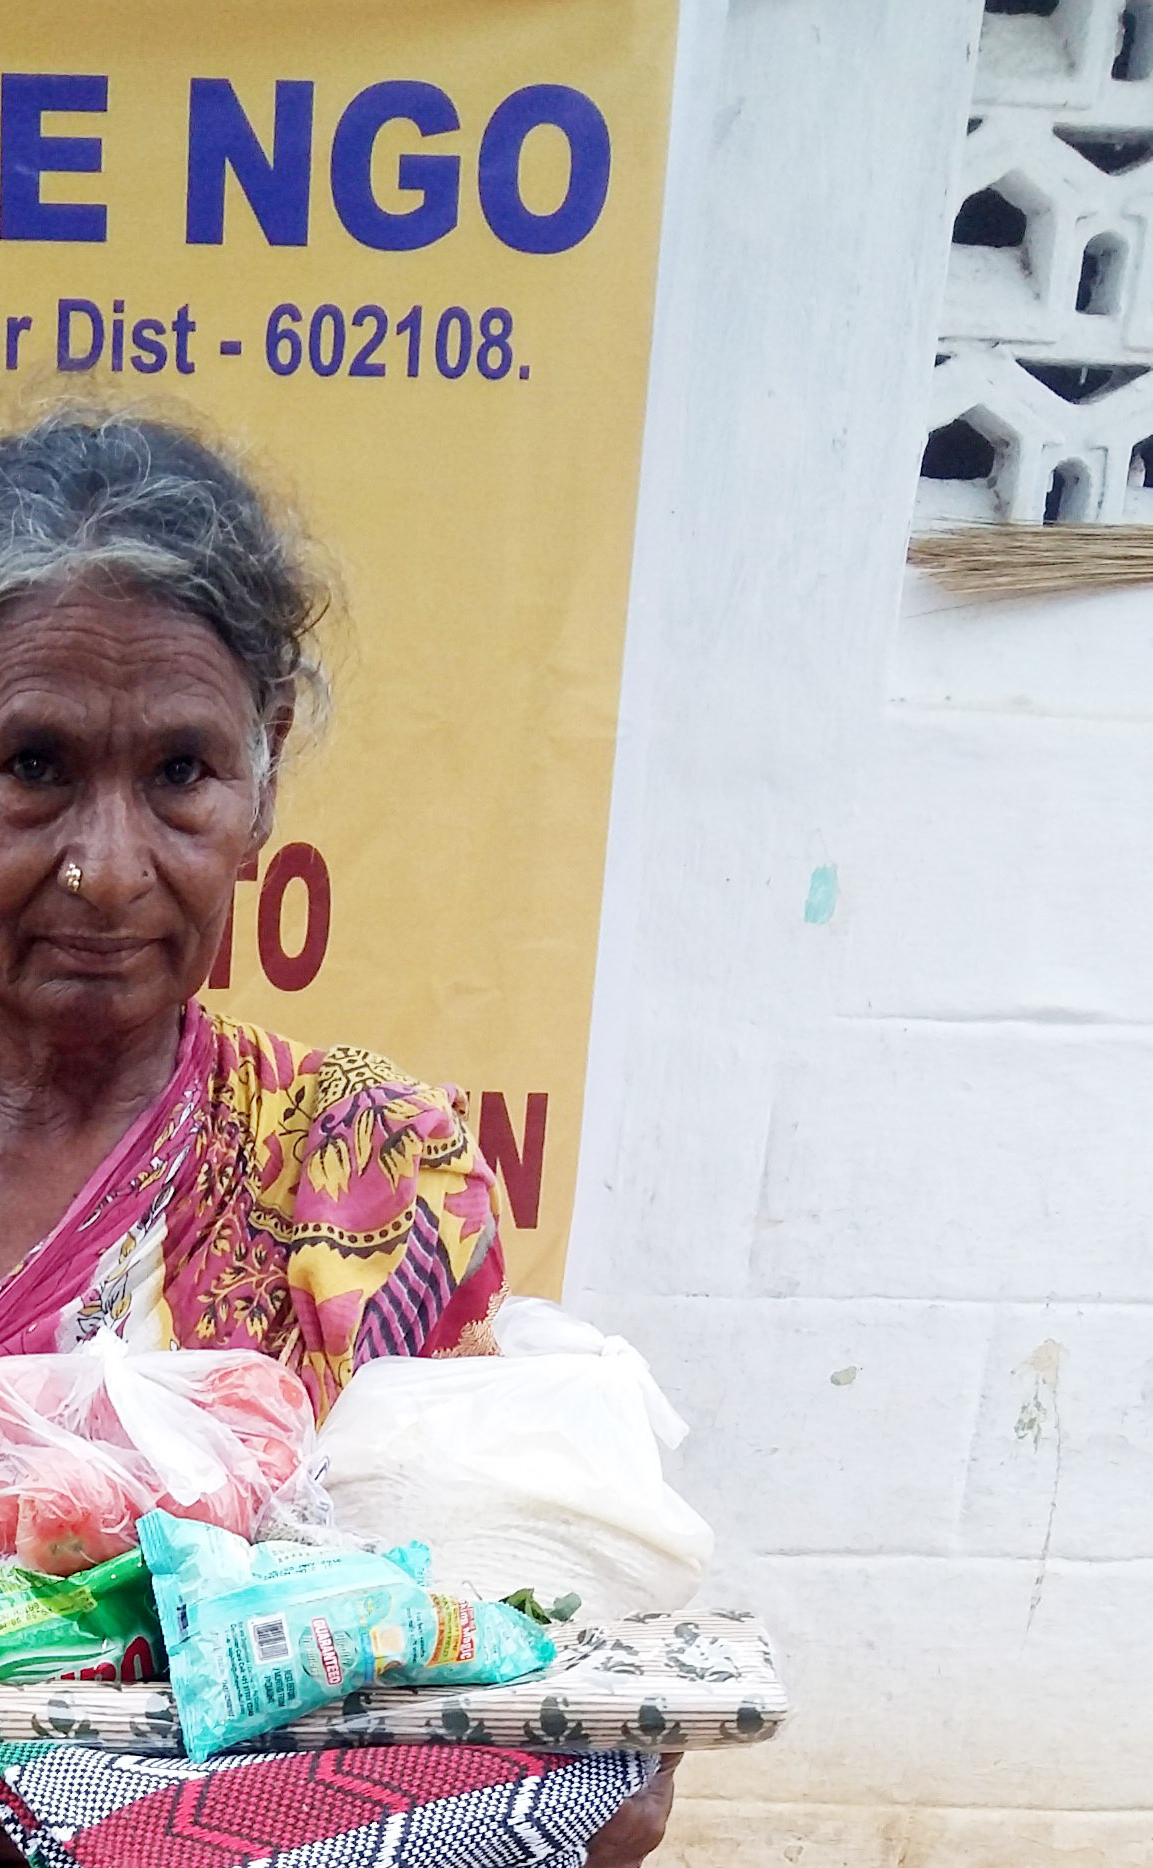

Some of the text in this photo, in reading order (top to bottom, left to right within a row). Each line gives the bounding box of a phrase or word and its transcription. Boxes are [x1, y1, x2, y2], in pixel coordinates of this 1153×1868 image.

[186, 78, 611, 255] NGO
[57, 298, 196, 375] Dist
[220, 340, 242, 355] -
[266, 303, 530, 381] 602108.
[311, 1618, 342, 1684] GUARANTEED
